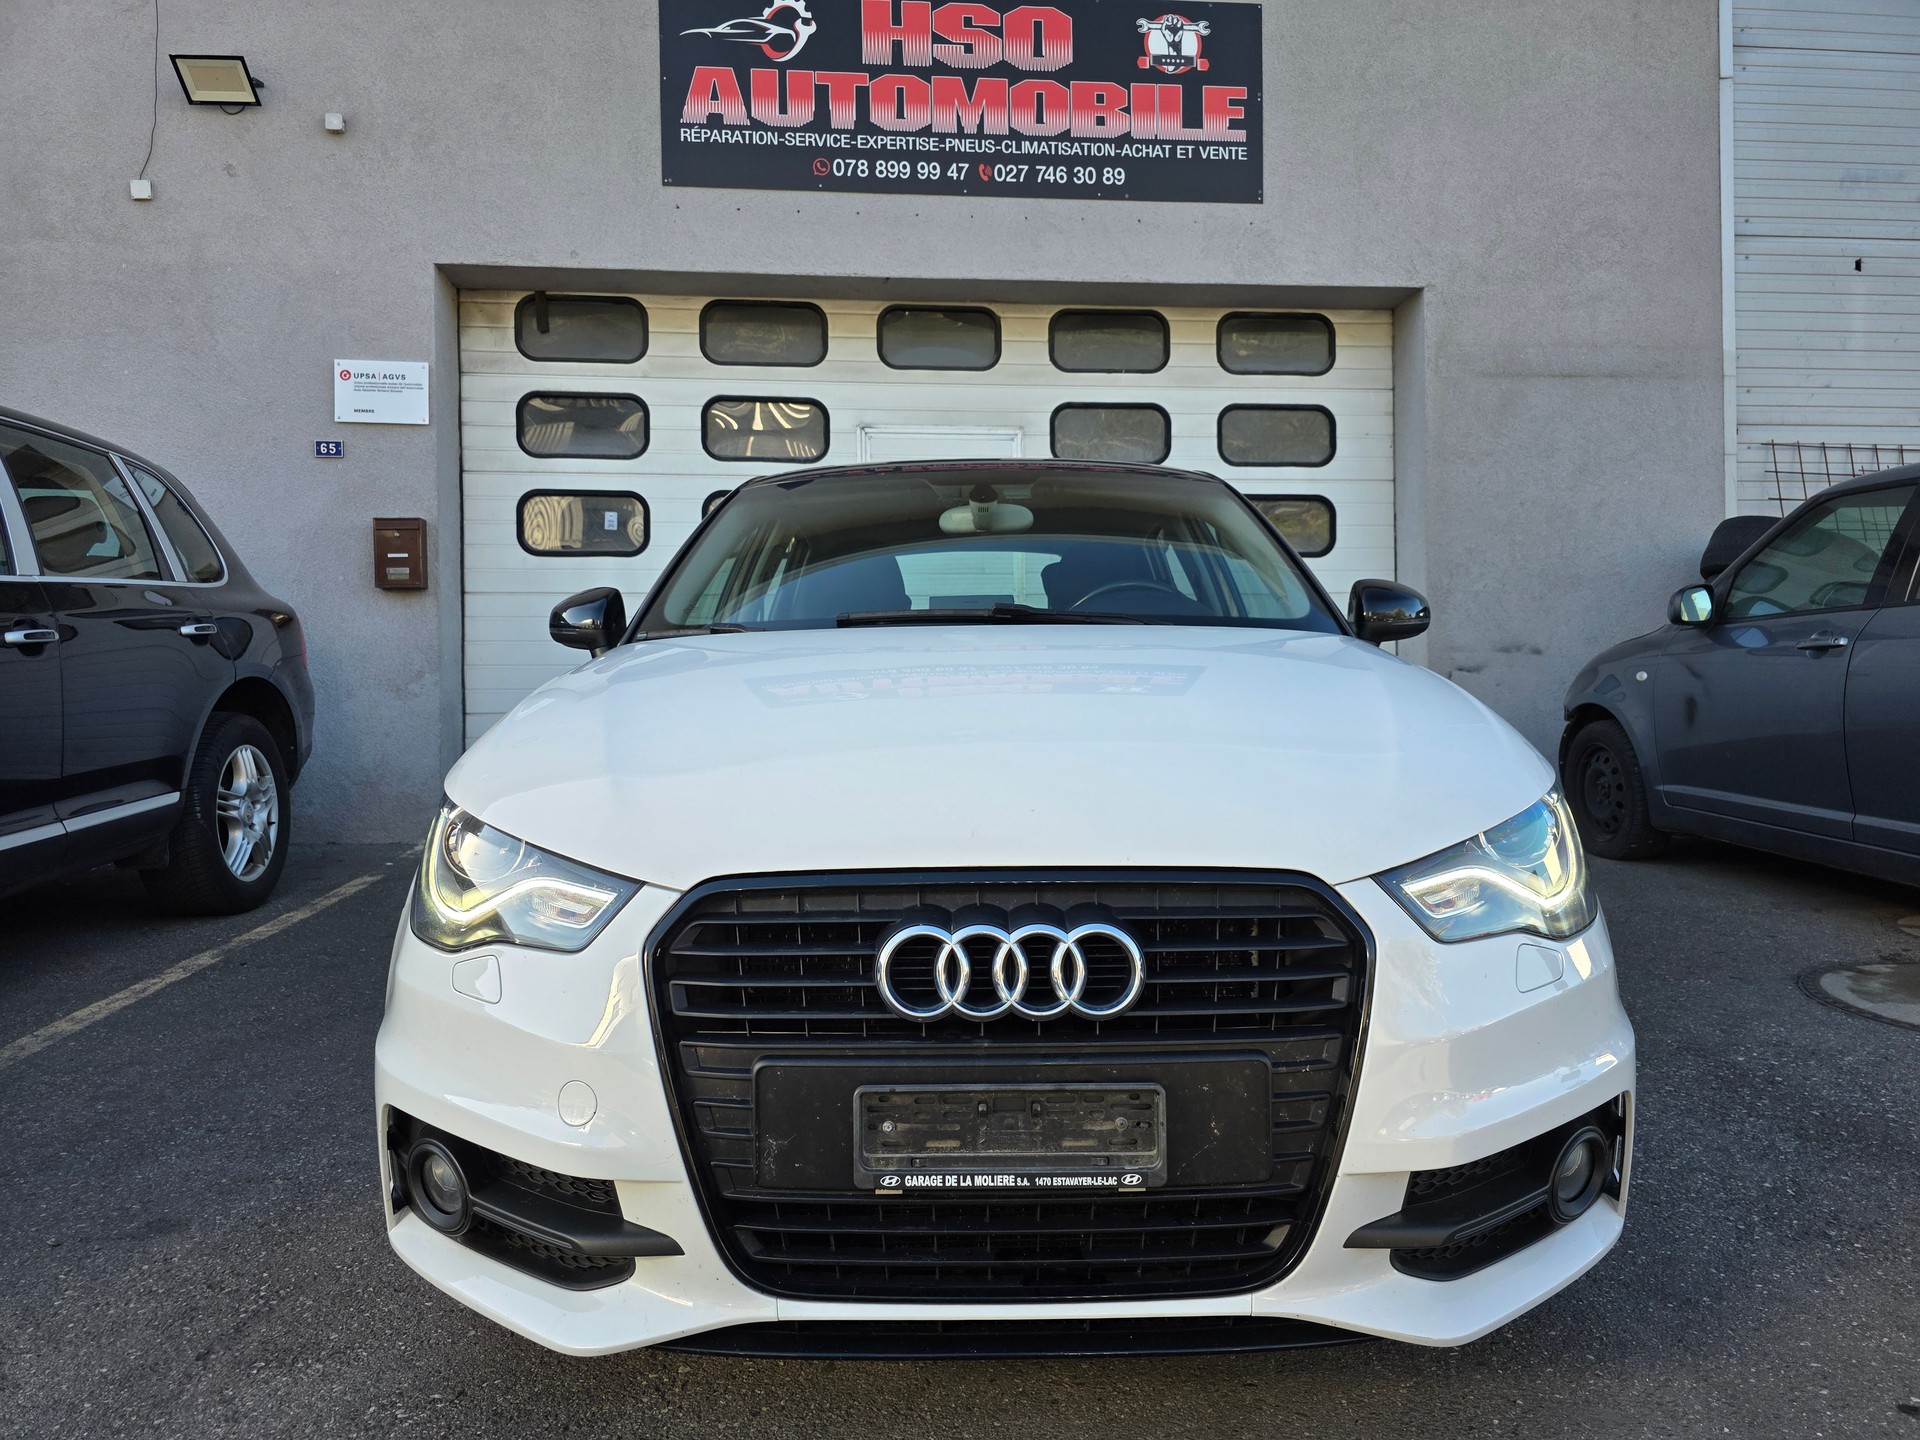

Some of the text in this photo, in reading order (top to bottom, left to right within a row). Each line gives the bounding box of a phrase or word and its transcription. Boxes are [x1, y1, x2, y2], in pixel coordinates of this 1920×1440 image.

[862, 0, 1073, 71] HSO
[680, 66, 1248, 143] AUTOMOBILE
[1177, 145, 1194, 159] ET
[1198, 145, 1248, 160] VENTE
[833, 159, 1126, 186] 078 899 99 47 027 746 30 89
[353, 372, 406, 381] UPSA AGVS
[320, 443, 336, 454] 65
[905, 1174, 1117, 1187] GARAGE DE LA MOLIERE S.A. 1470 ESTAVAYER-LE-LAC
